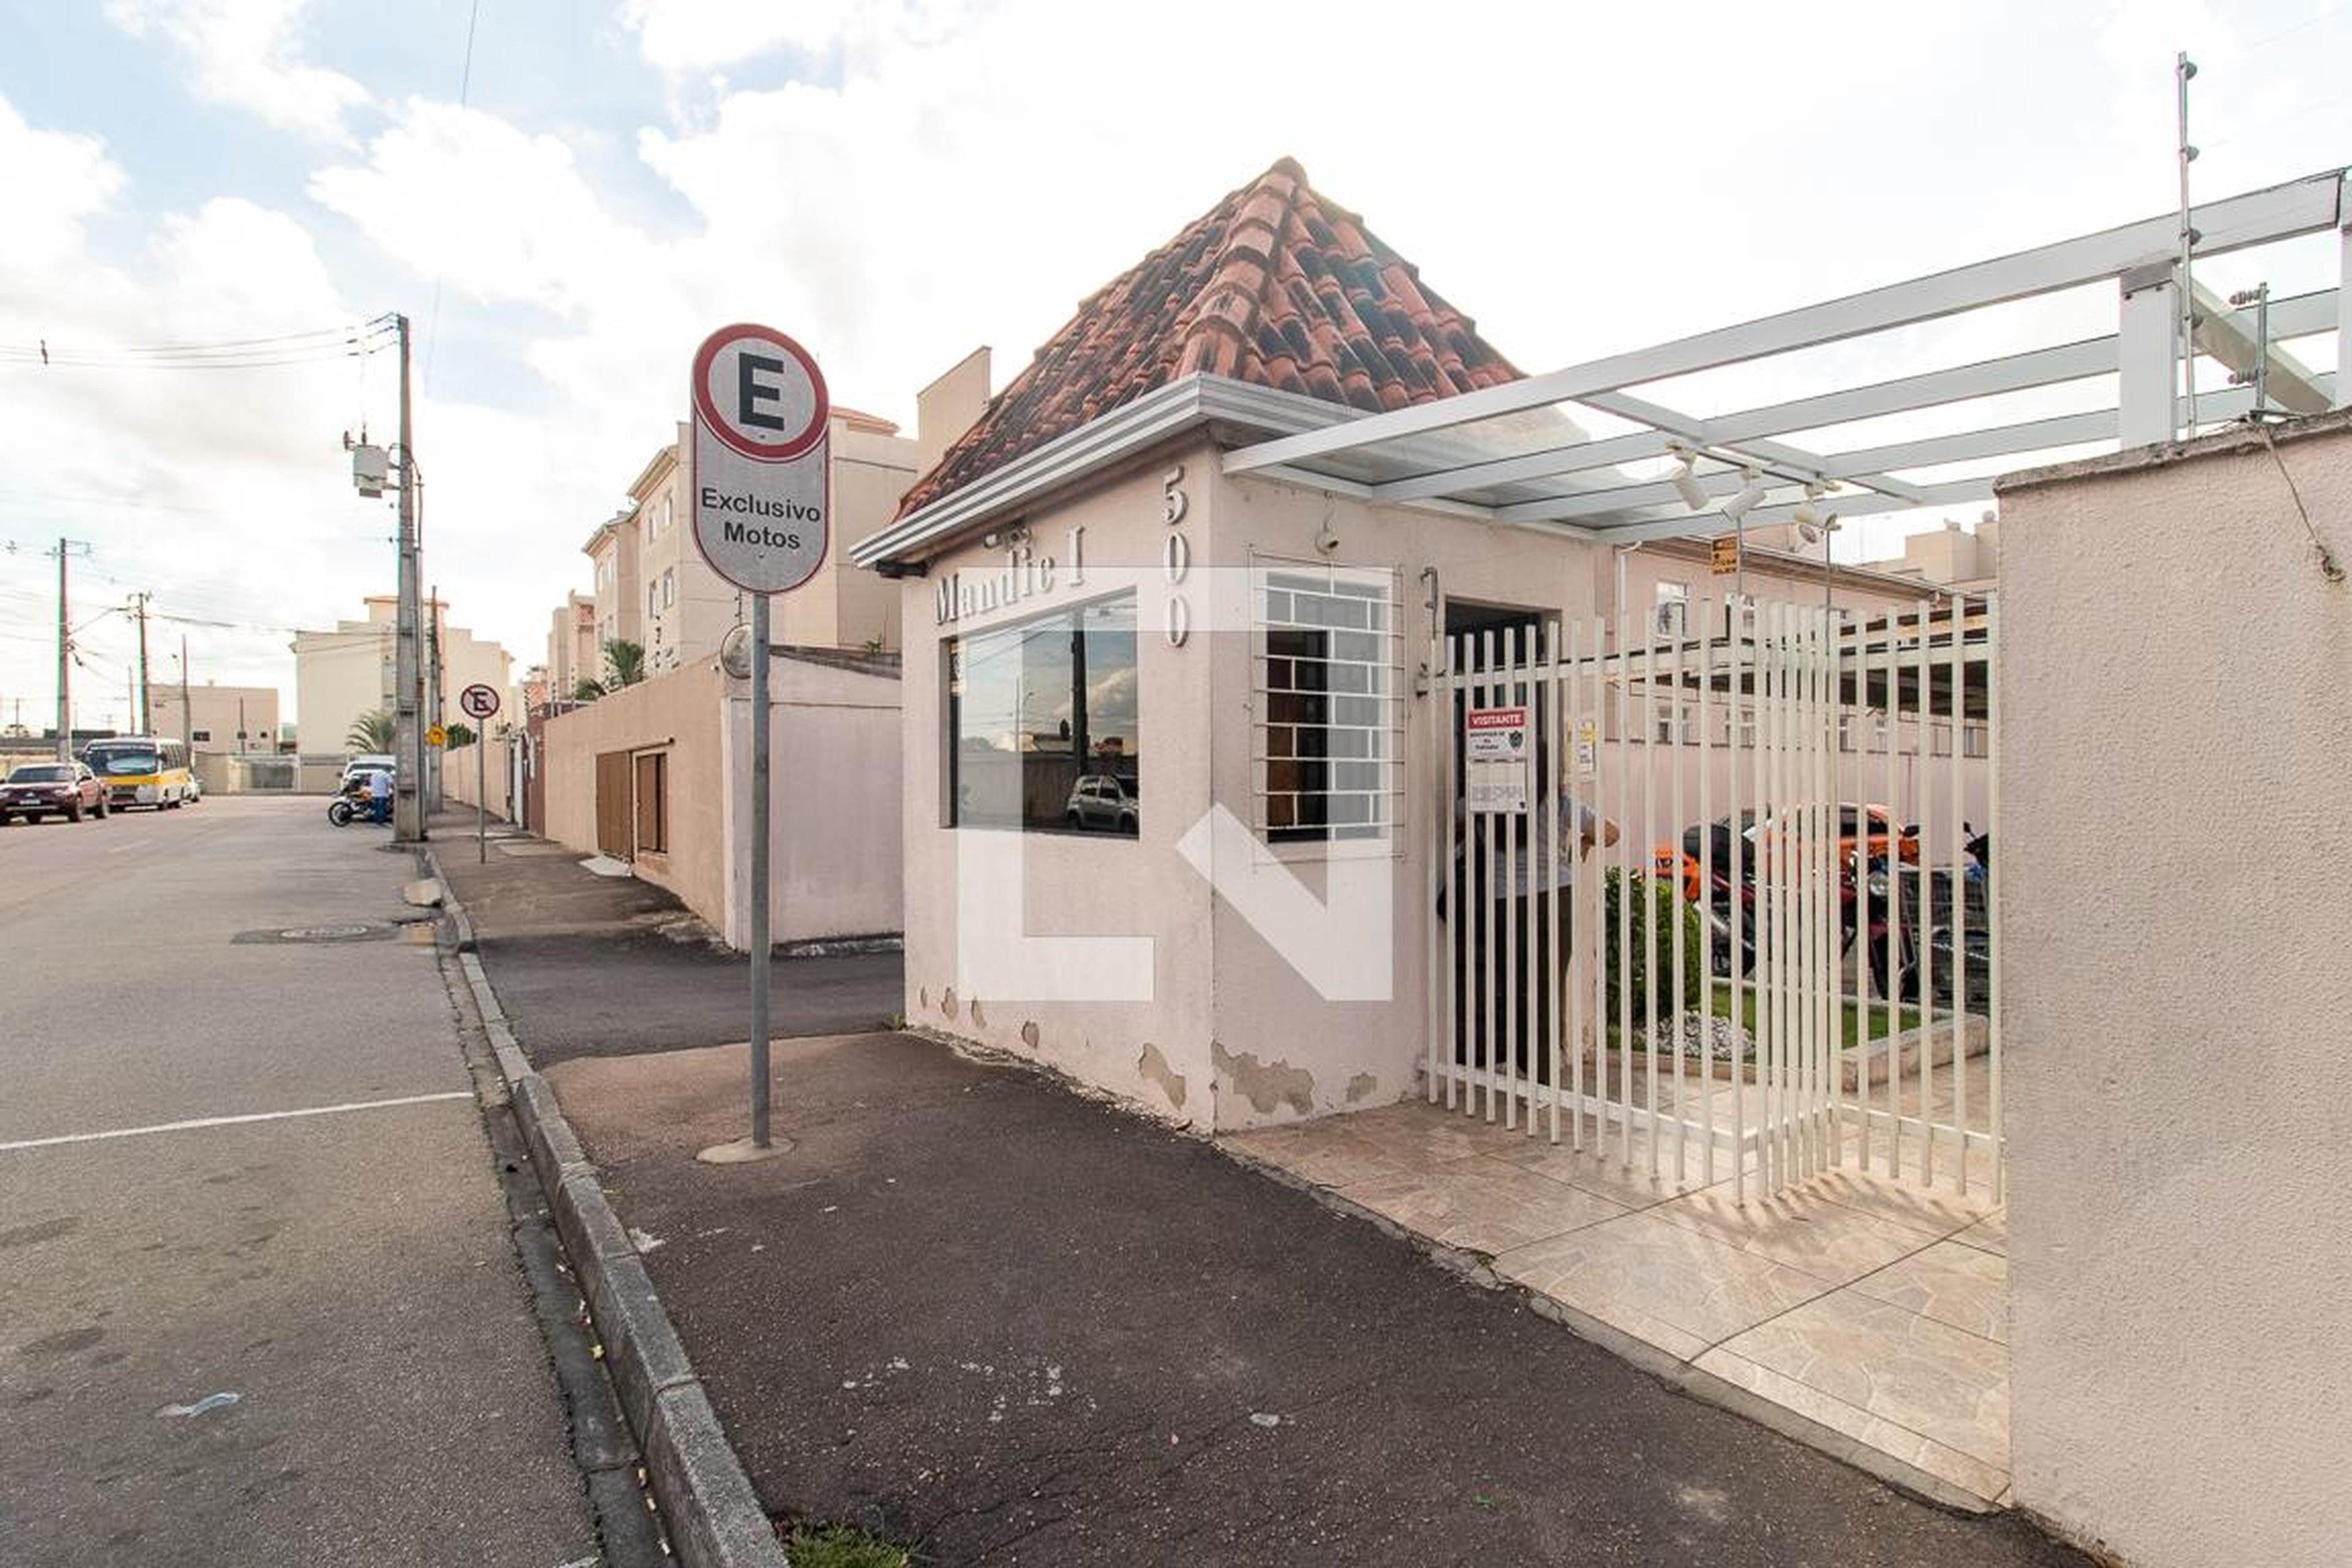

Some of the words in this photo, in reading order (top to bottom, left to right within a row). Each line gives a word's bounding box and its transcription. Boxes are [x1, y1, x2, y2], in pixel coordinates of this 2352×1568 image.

[739, 352, 785, 431] E
[701, 487, 821, 522] Exclusivo
[724, 521, 801, 550] Motos
[1471, 714, 1522, 726] VISITANTE
